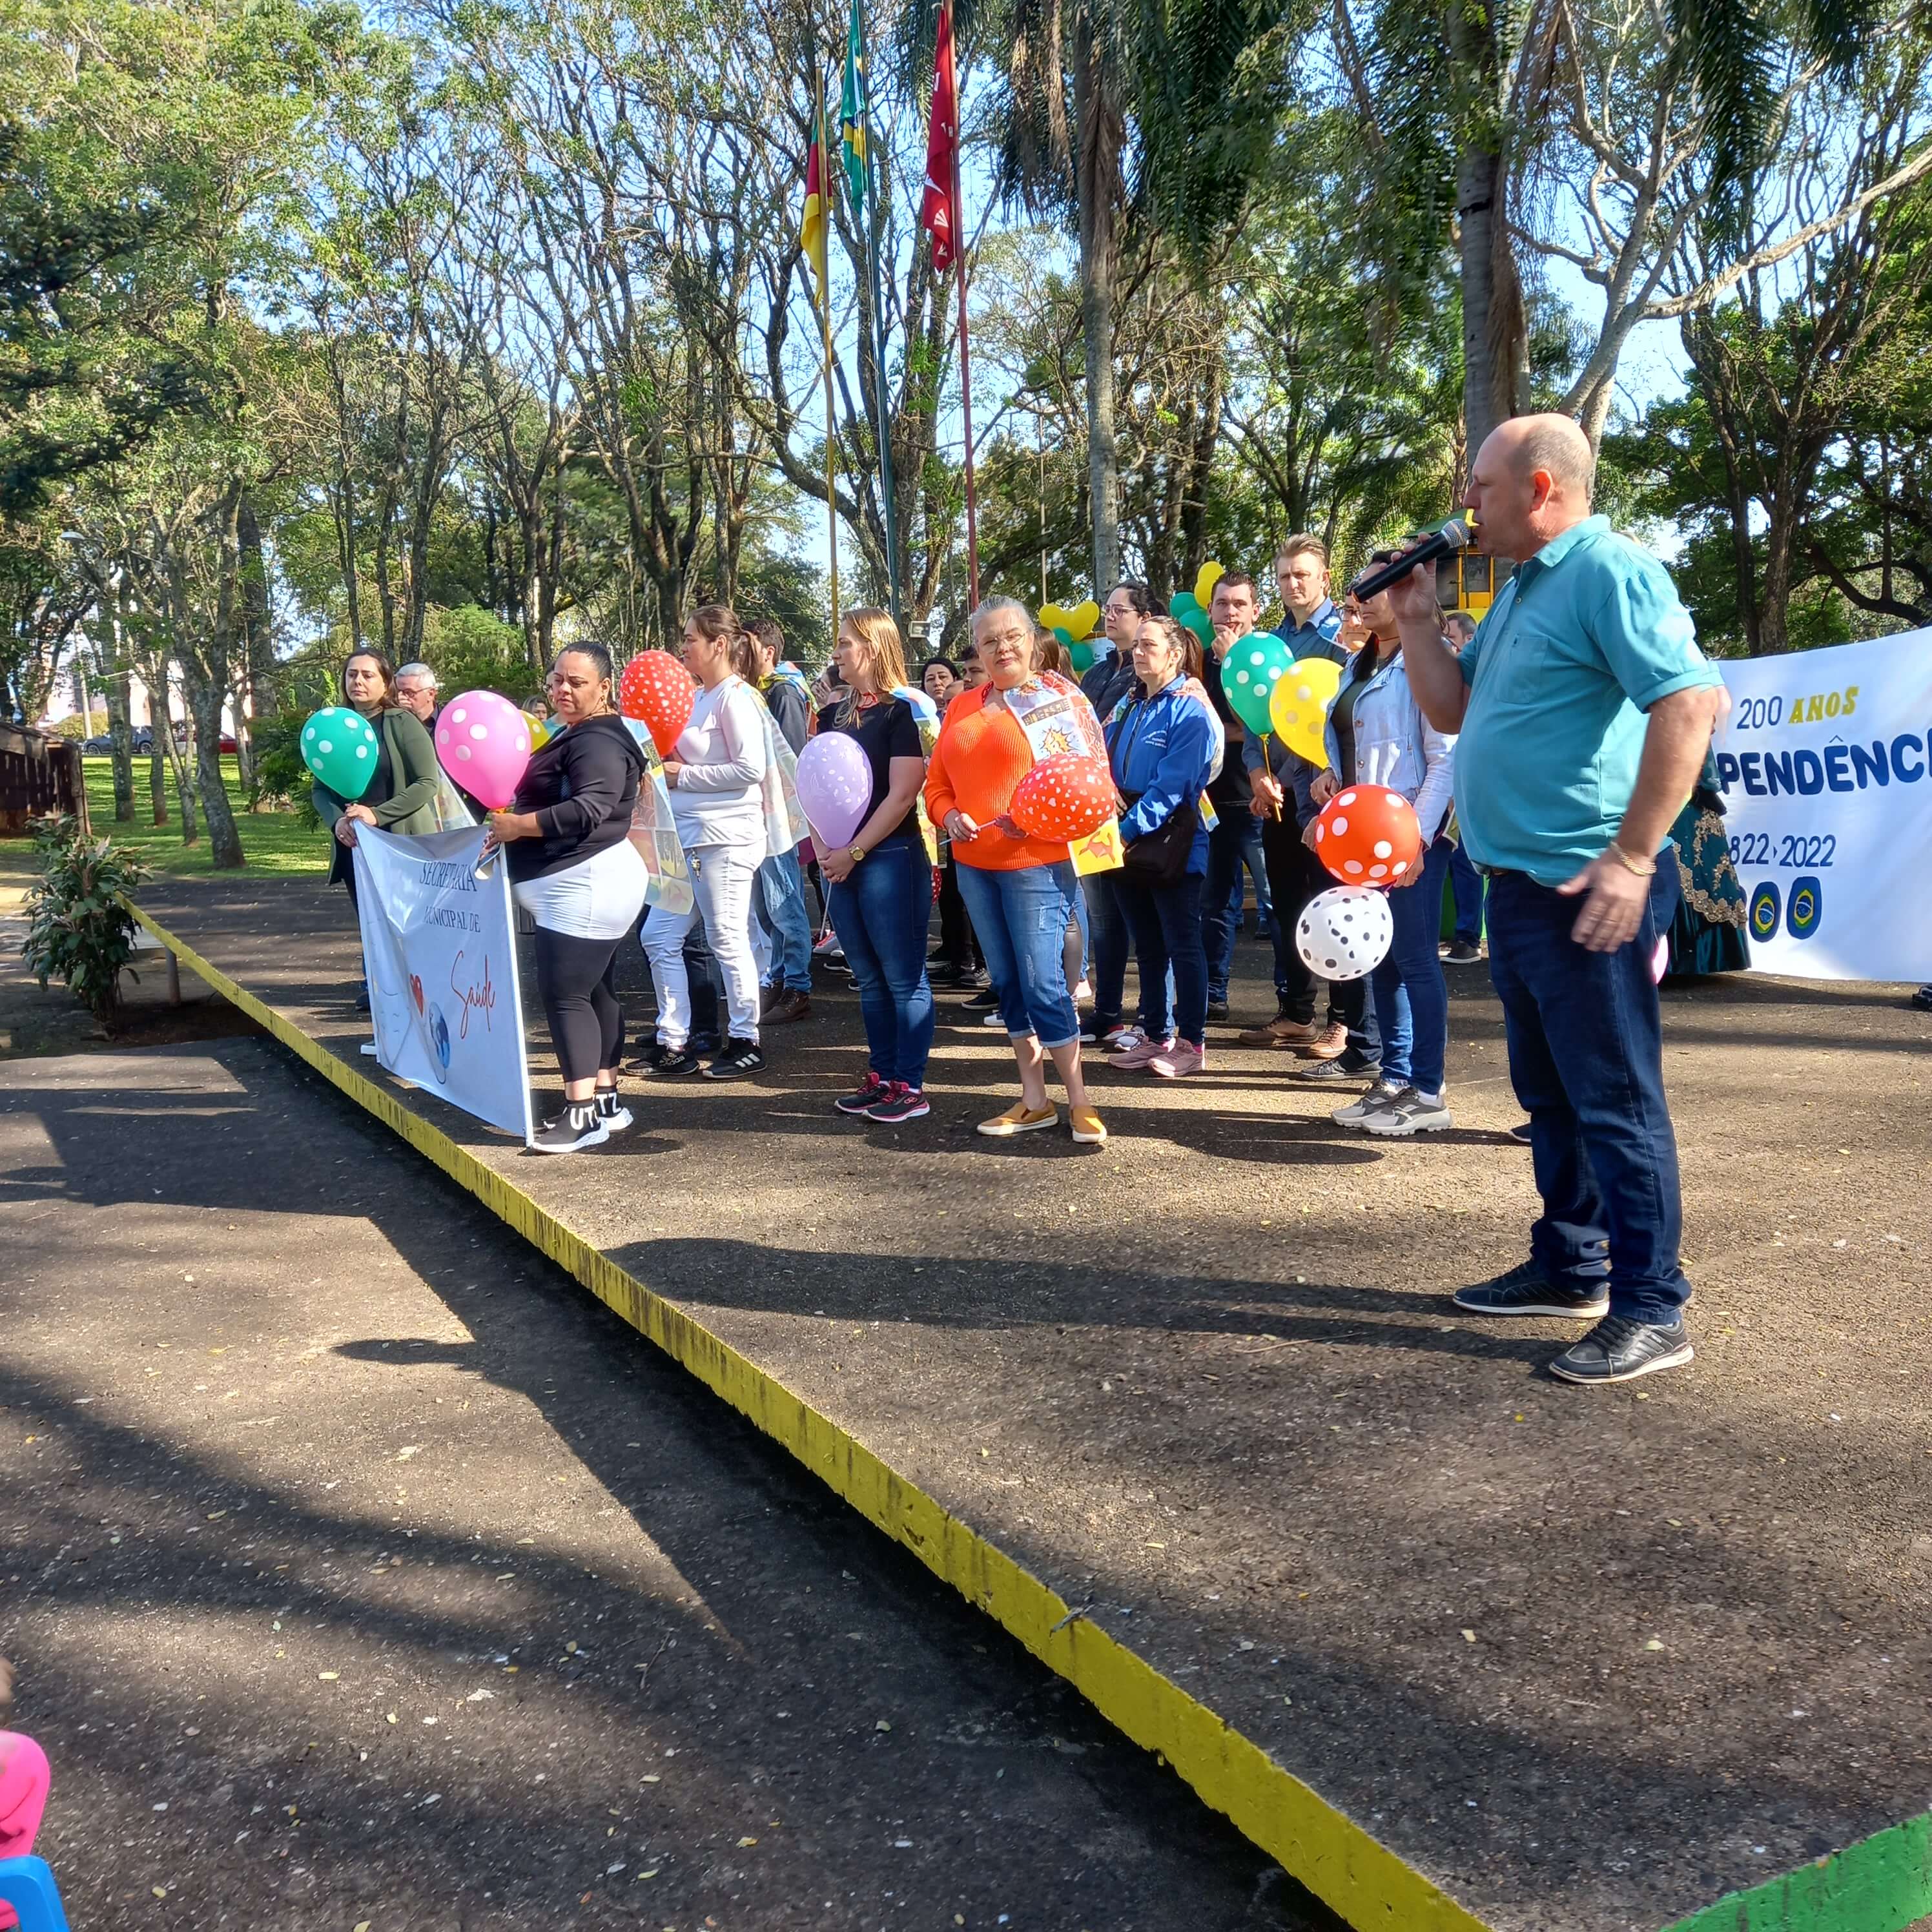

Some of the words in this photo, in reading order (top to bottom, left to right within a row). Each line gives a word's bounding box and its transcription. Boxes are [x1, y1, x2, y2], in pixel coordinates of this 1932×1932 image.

[1736, 695, 1783, 730] 200
[1787, 685, 1860, 724] ANOS
[1778, 834, 1836, 868] 2022
[419, 861, 477, 892] SECRETARIA
[469, 912, 481, 933] DE
[451, 950, 496, 1040] Saúde
